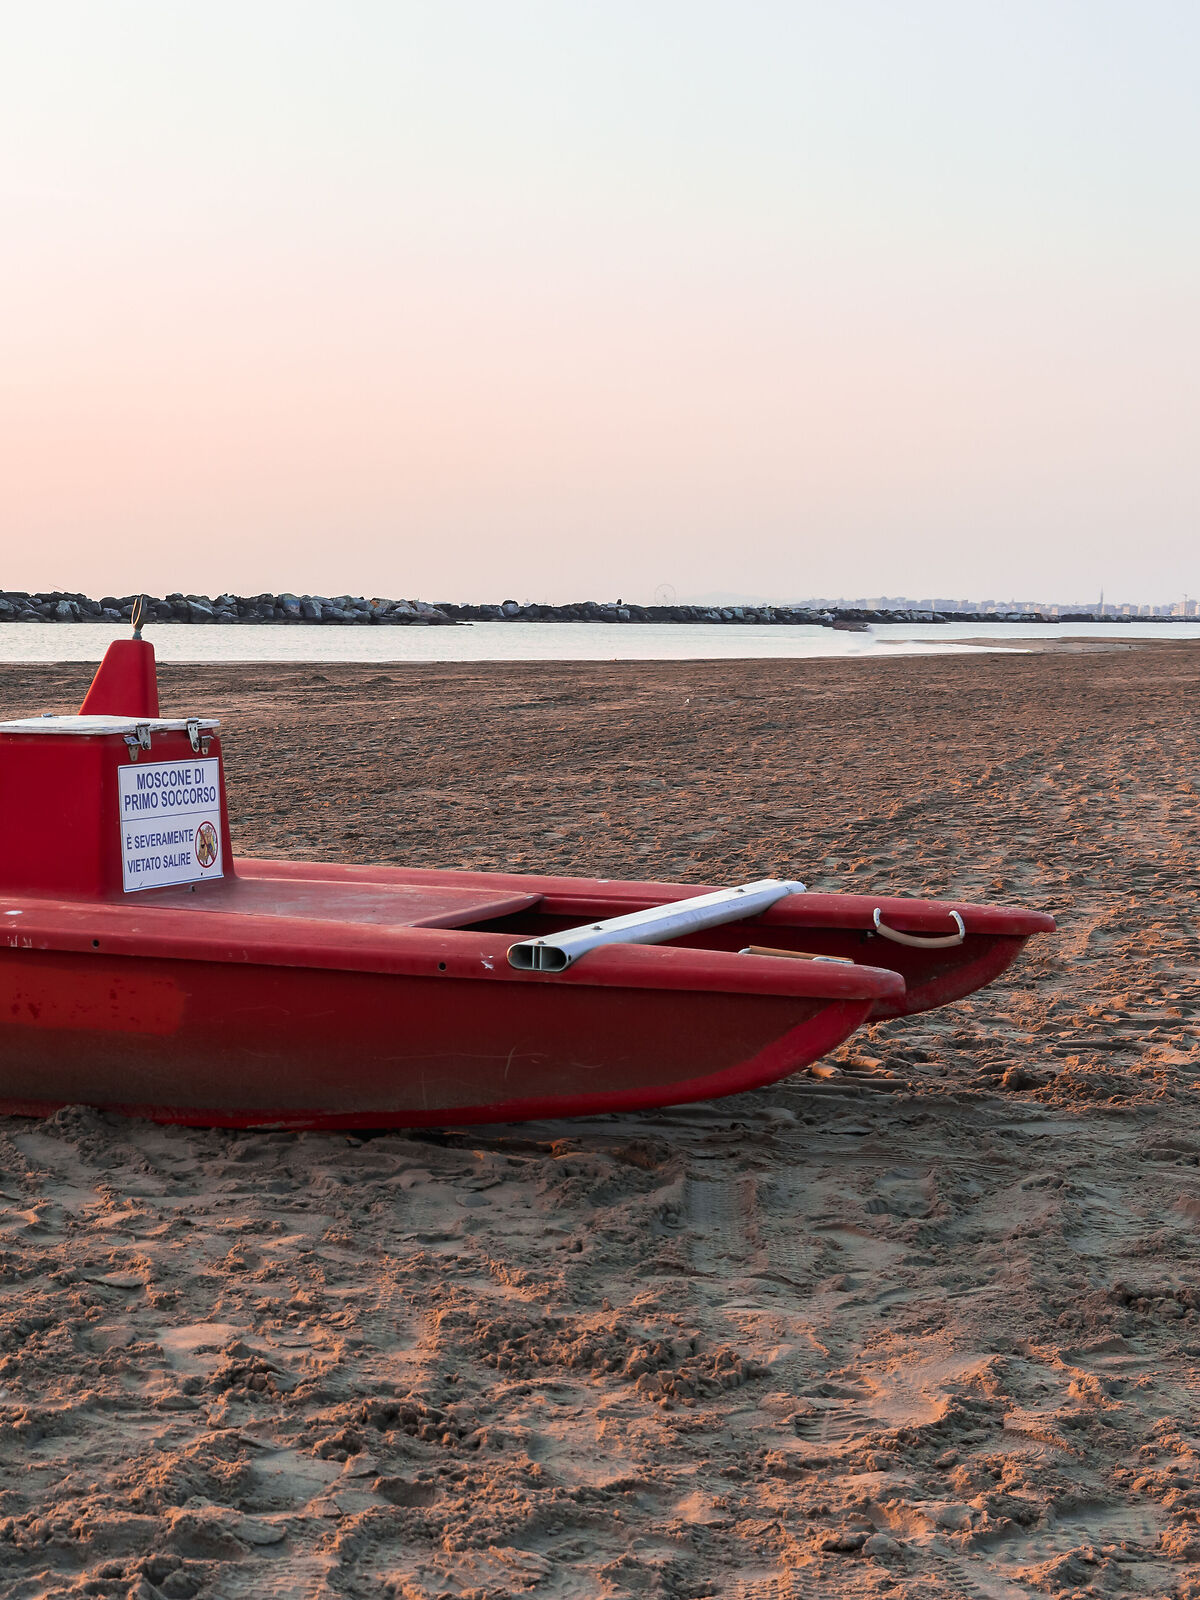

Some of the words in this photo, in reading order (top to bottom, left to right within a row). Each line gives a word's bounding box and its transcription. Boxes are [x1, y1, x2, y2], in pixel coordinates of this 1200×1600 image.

[137, 769, 191, 790] MOSCONE
[194, 768, 204, 784] DI
[124, 792, 159, 812] PRIMO
[161, 786, 216, 807] SOCCORSO
[126, 834, 133, 850] È
[134, 828, 194, 849] SEVERAMENTE
[127, 858, 161, 874] VIETATO
[163, 852, 191, 869] SALIRE
